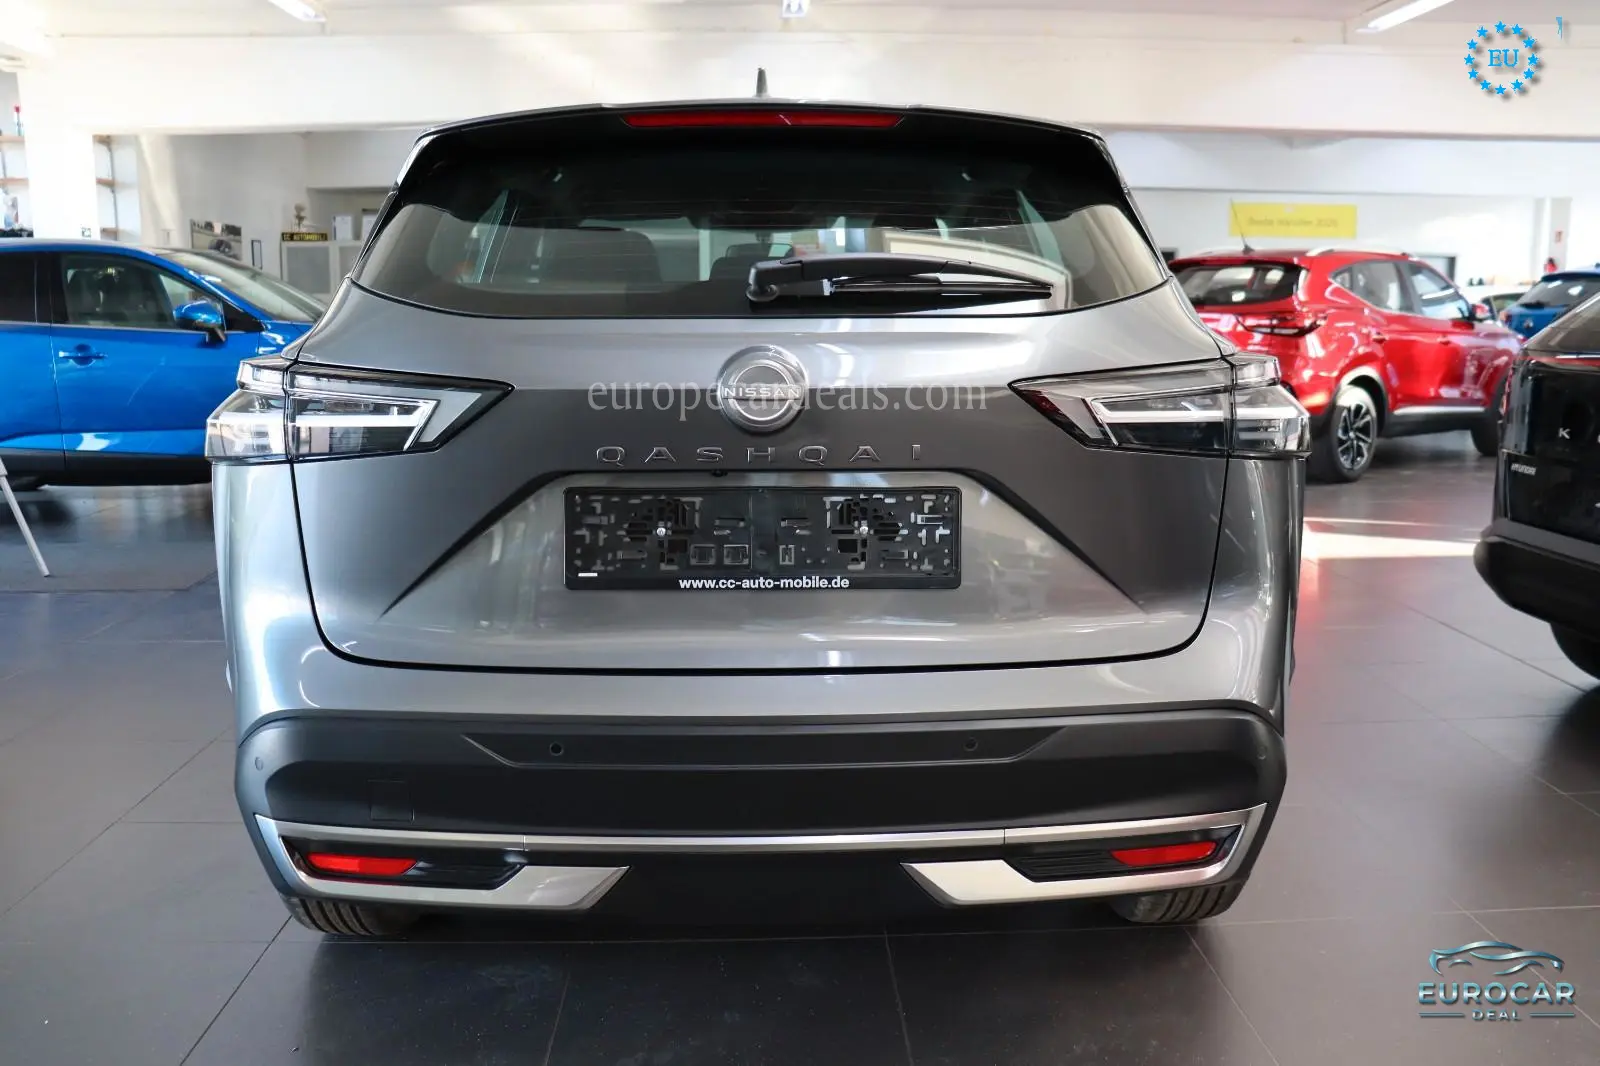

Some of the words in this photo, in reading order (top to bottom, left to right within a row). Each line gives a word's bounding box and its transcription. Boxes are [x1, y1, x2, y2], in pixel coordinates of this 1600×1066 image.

[724, 386, 800, 399] NISSAN
[596, 443, 922, 467] QASHQAI
[679, 575, 850, 589] www.cc-auto-mobile.de
